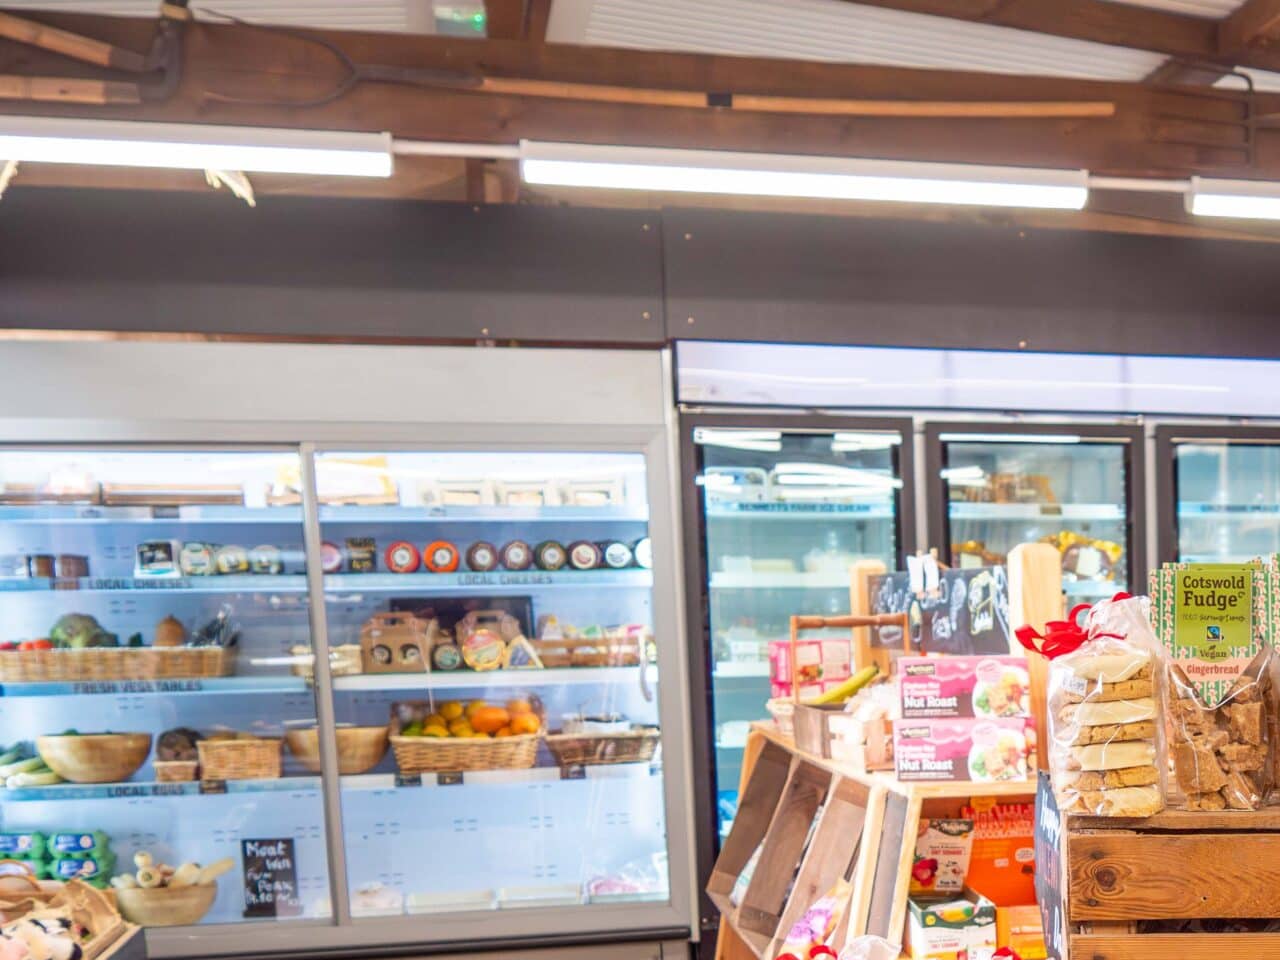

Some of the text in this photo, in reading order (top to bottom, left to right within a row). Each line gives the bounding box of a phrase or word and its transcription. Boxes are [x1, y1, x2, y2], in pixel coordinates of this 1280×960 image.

[88, 579, 128, 590] LOCAL
[457, 573, 494, 585] LOCAL
[1183, 576, 1245, 589] Cotswold
[1183, 590, 1238, 610] Fudge
[1200, 650, 1227, 659] Vegan
[1187, 664, 1239, 676] Gingerbread
[107, 785, 147, 798] LOCAL
